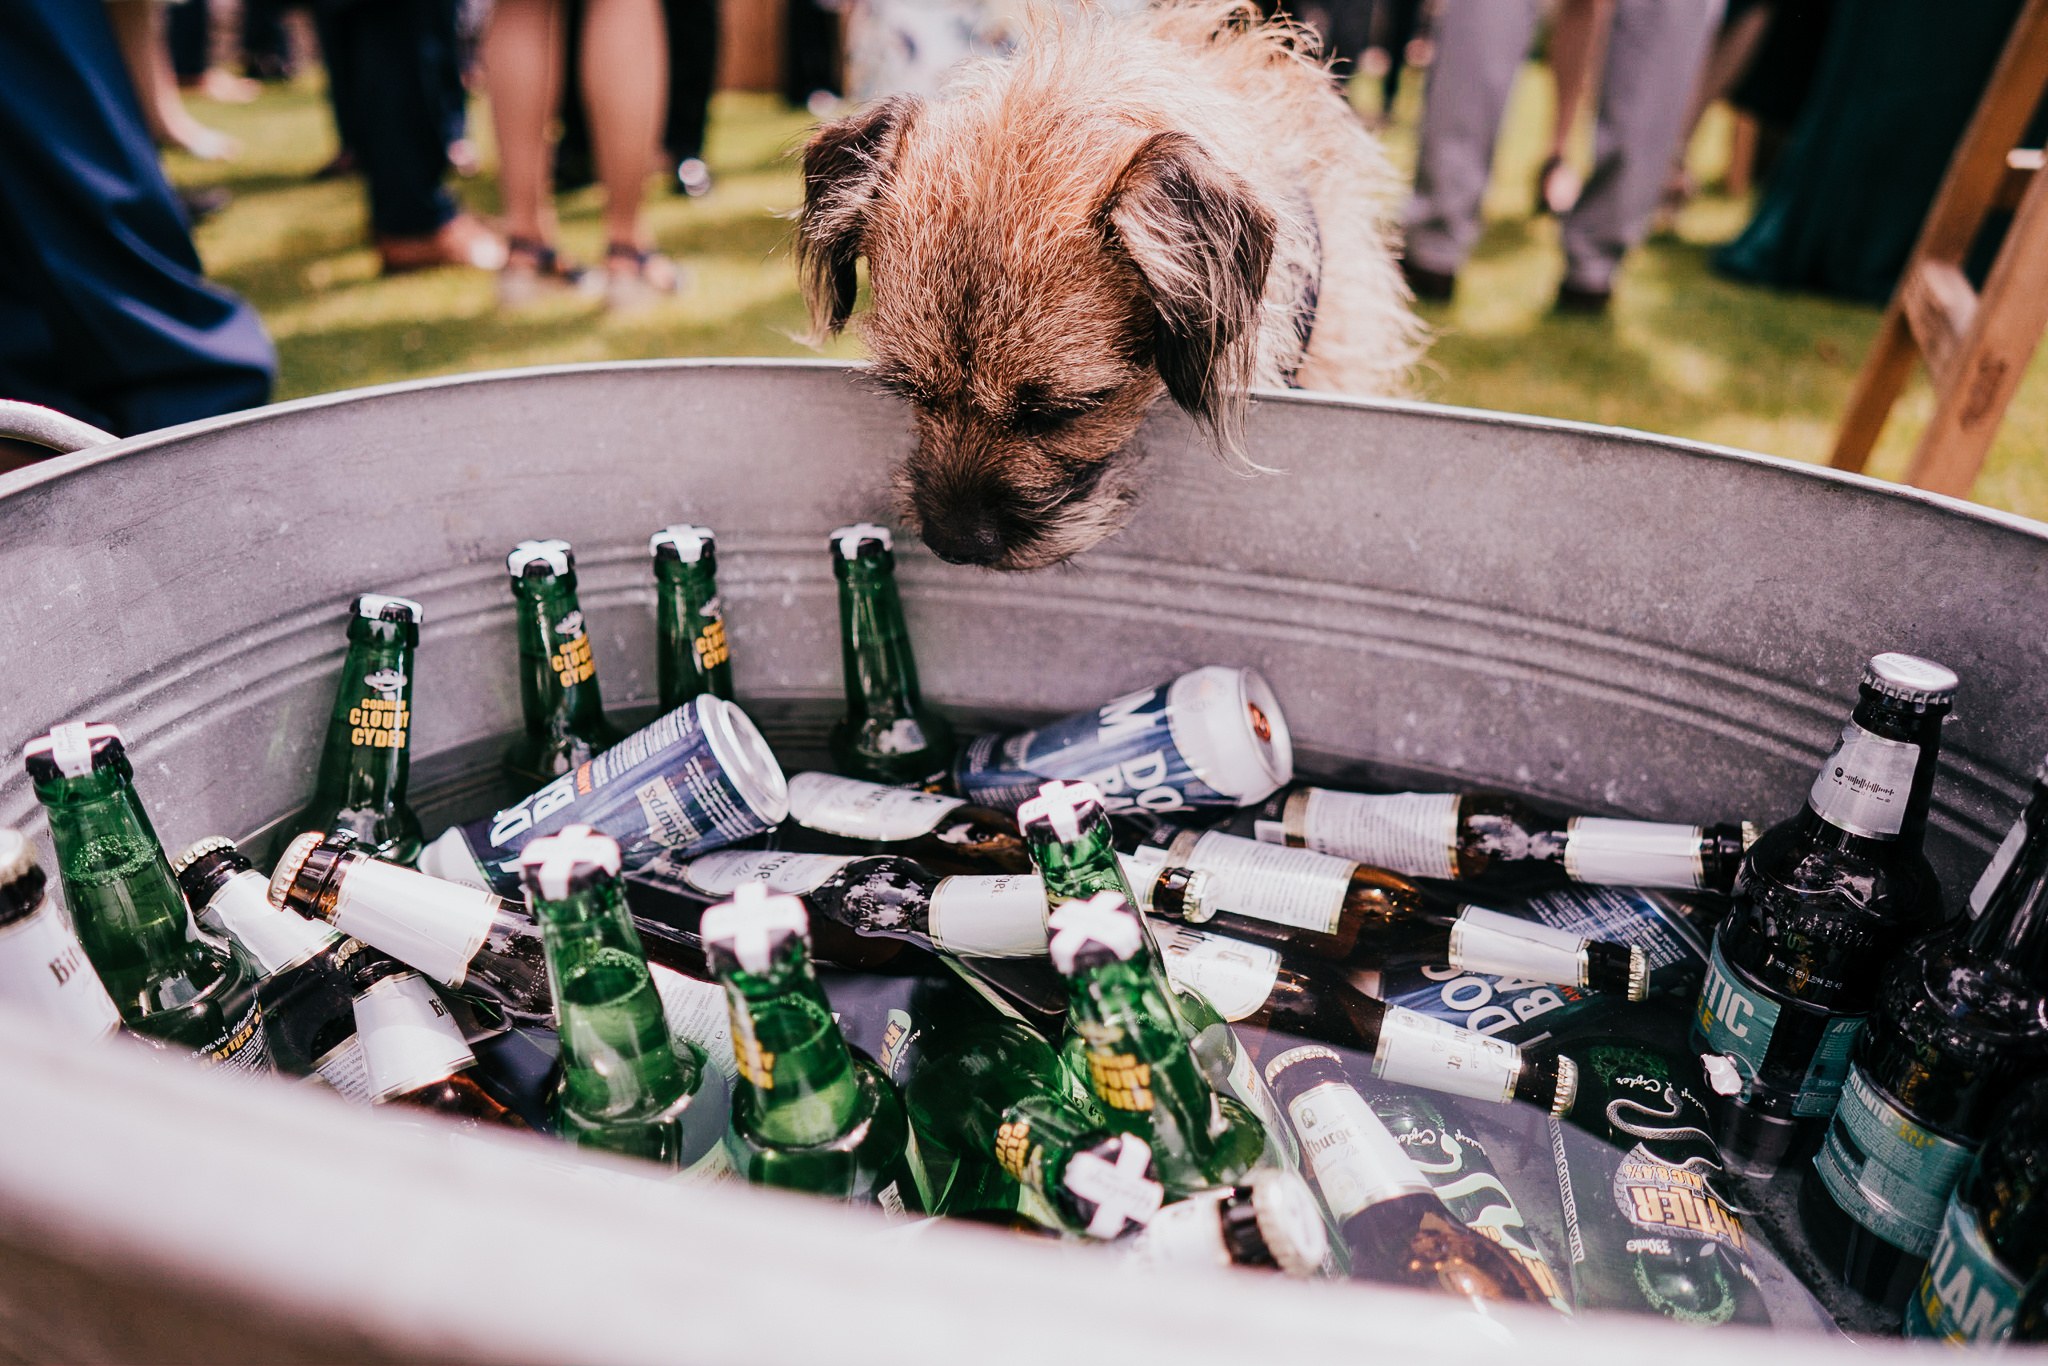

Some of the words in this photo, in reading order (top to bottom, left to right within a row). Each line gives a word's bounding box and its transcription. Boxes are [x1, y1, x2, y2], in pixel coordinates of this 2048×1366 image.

[351, 727, 407, 748] CYDER
[908, 1029, 921, 1044] Alc
[1615, 1074, 1662, 1094] Cyder
[1849, 1071, 1894, 1127] ATLANTIC
[1552, 1132, 1566, 1161] THE
[1622, 1162, 1671, 1181] 8.4%
[1671, 1168, 1702, 1190] ALC
[1556, 1159, 1578, 1228] CORNISH
[1567, 1224, 1586, 1266] WAY
